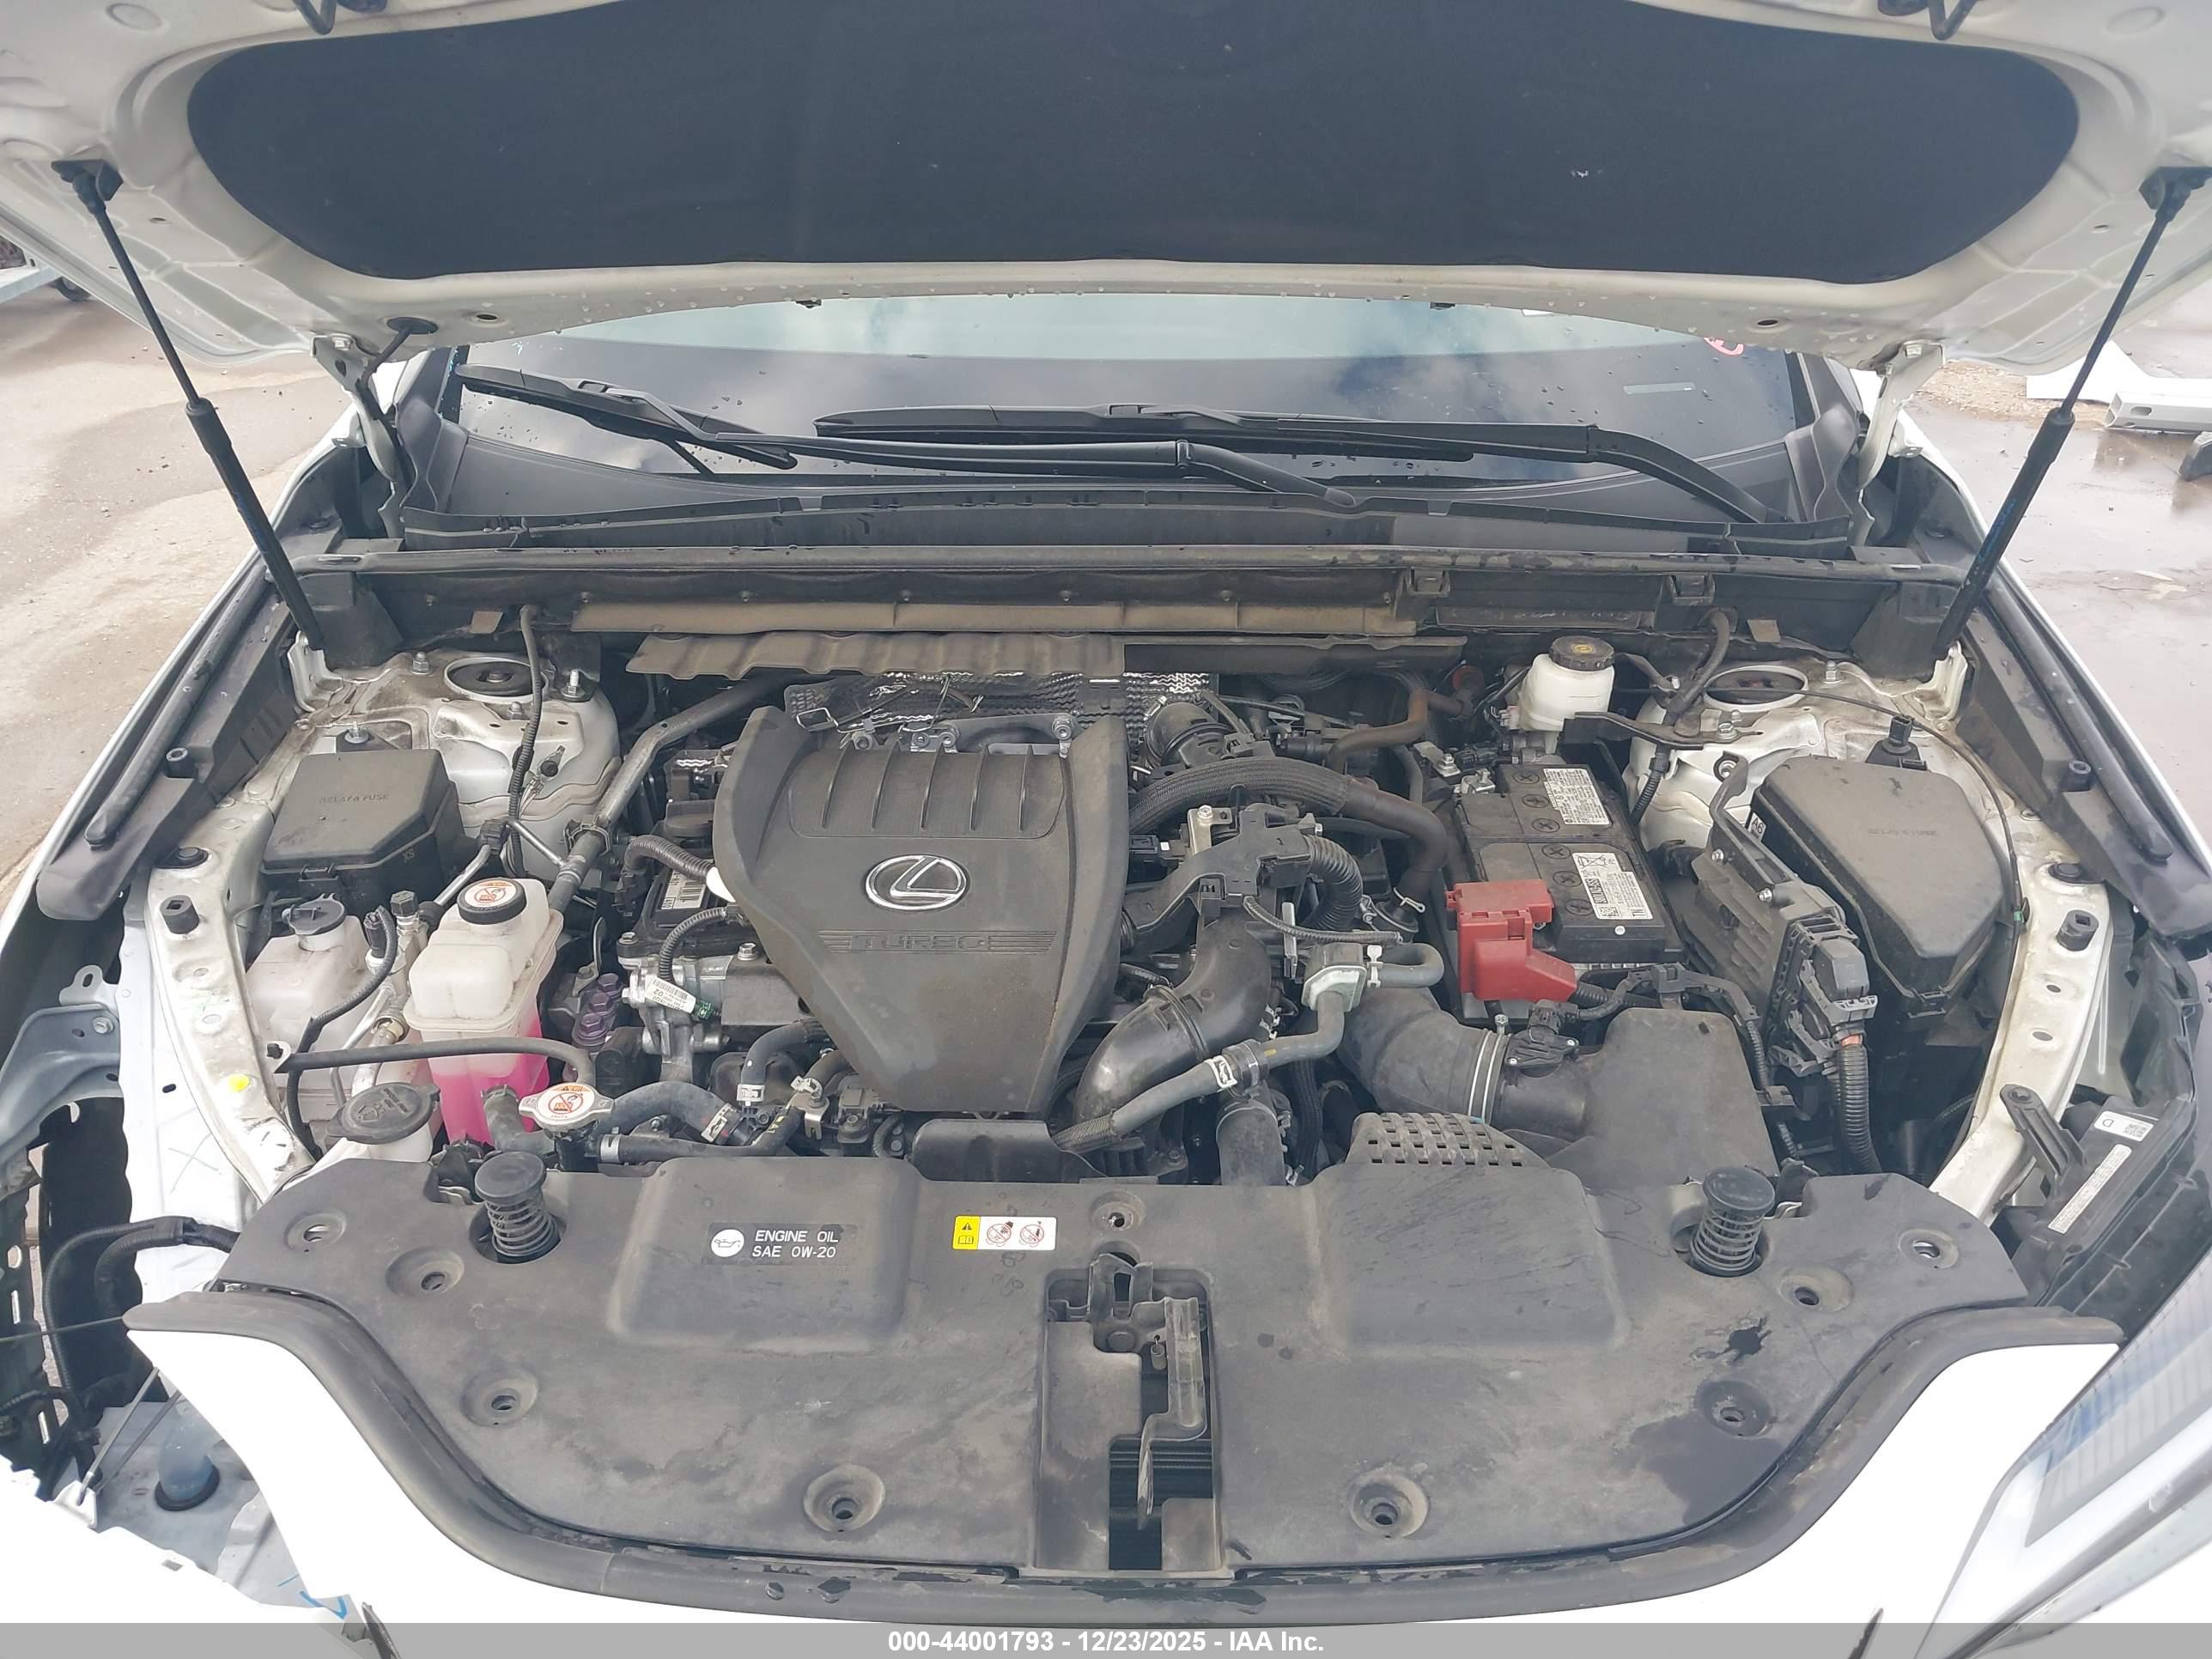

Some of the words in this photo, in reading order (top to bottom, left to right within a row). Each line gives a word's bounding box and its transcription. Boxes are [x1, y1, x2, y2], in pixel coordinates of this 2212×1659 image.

[1751, 817, 1763, 834] A6
[853, 934, 985, 950] TURBO
[755, 1230, 808, 1243] ENGINE
[817, 1231, 839, 1243] OIL
[751, 1245, 782, 1258] SAE
[791, 1245, 836, 1258] 0W-20
